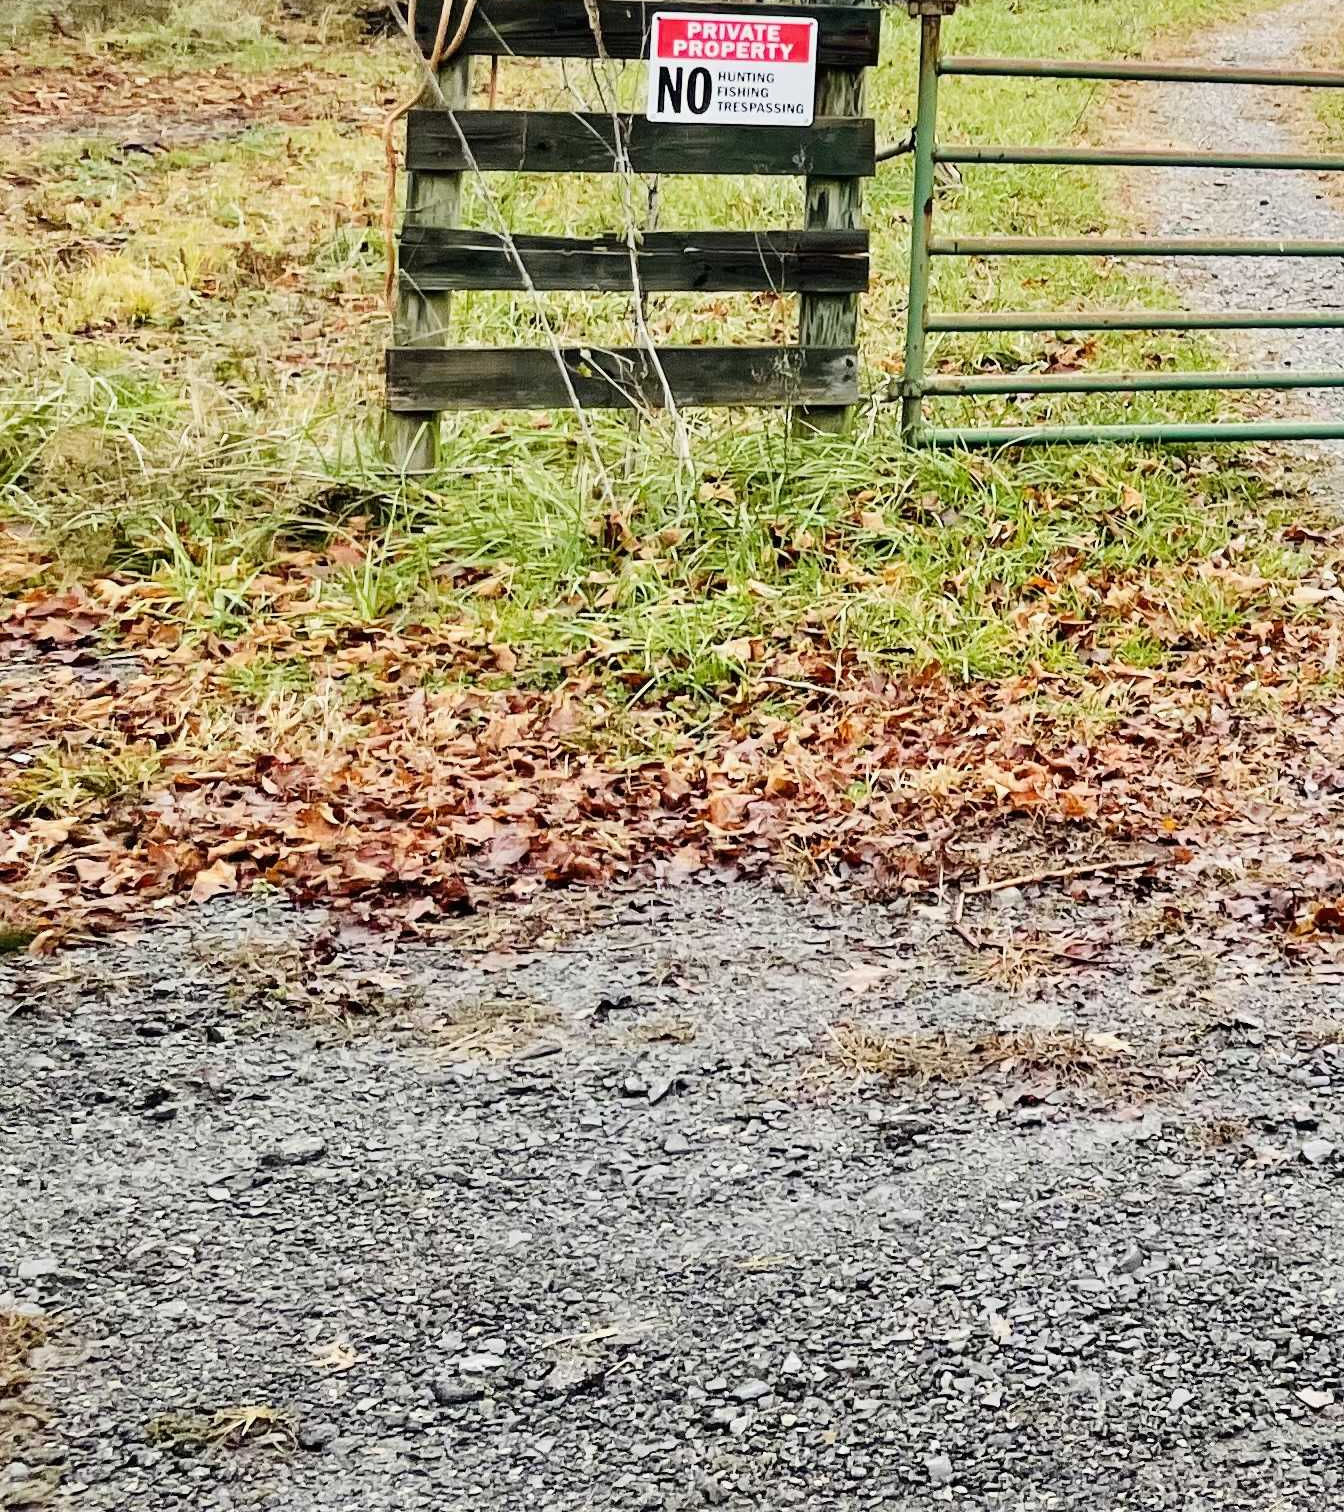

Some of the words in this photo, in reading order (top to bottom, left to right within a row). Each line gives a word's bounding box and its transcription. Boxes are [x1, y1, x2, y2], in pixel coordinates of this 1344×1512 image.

[687, 21, 781, 41] PRIVATE
[672, 39, 793, 60] PROPERTY
[717, 71, 775, 83] HUNTING
[656, 66, 713, 115] NO
[717, 86, 769, 98] FISHING
[717, 102, 804, 114] TRESPASSING
